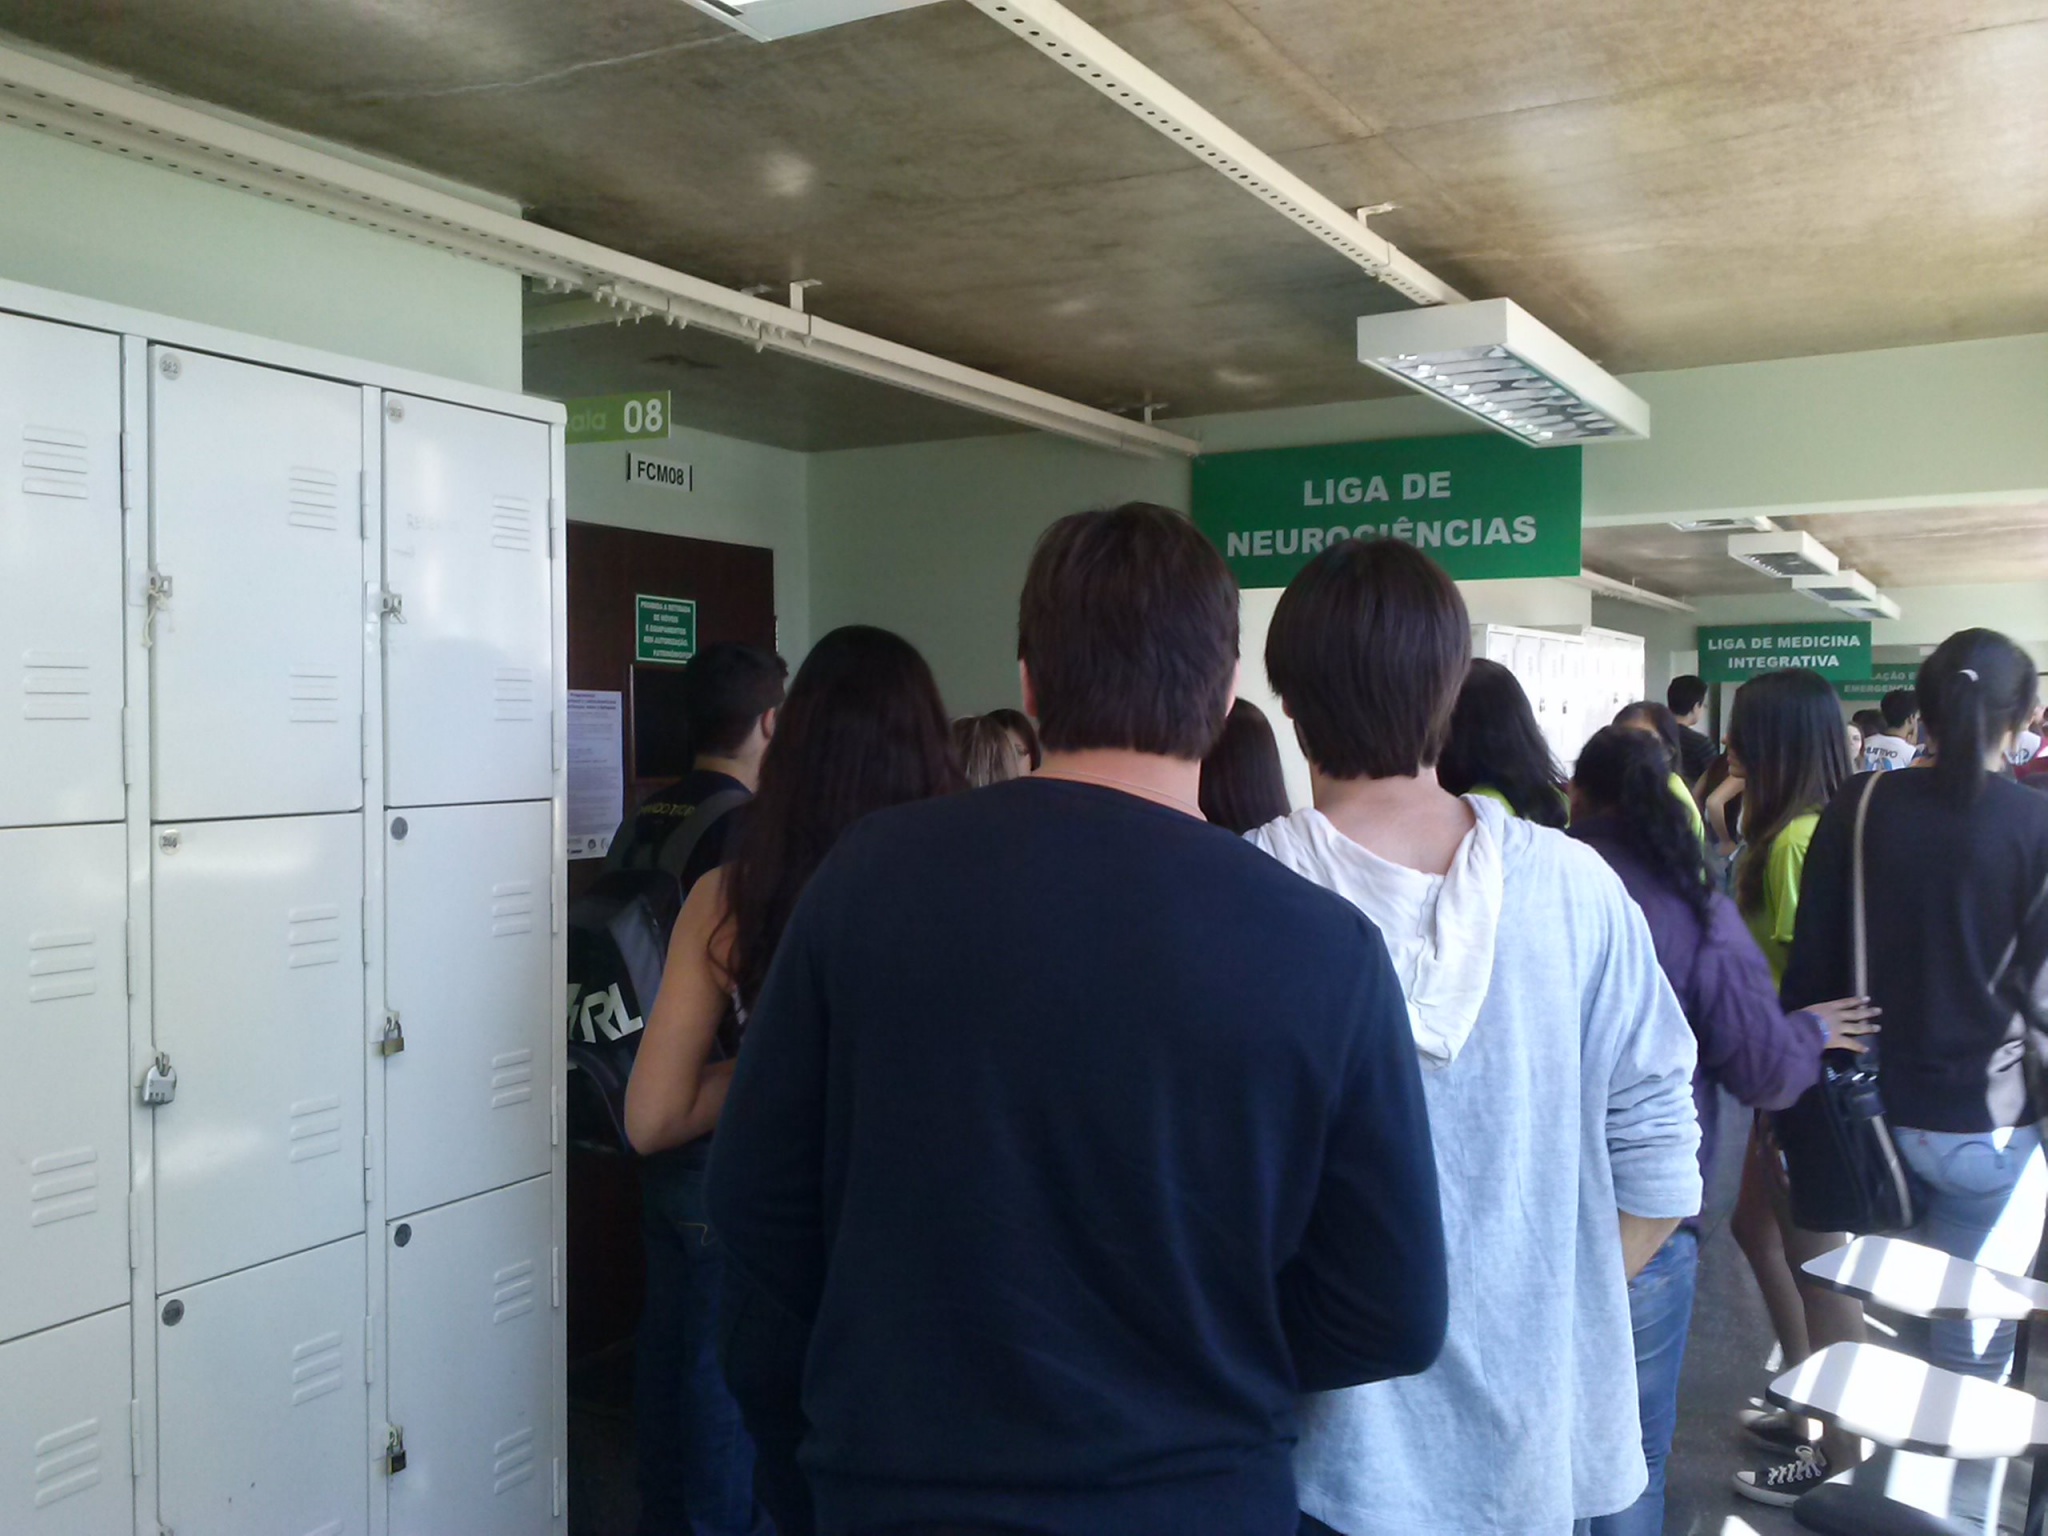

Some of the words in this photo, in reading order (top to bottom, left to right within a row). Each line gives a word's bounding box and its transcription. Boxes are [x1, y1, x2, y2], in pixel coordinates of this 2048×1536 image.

[623, 398, 663, 433] 08
[637, 460, 684, 485] FCM08
[1303, 477, 1389, 506] LIGA
[1402, 471, 1451, 501] DE
[1708, 638, 1747, 651] LIGA
[1751, 637, 1773, 649] DE
[1777, 635, 1861, 648] MEDICINA
[1728, 655, 1840, 669] INTEGRATIVA
